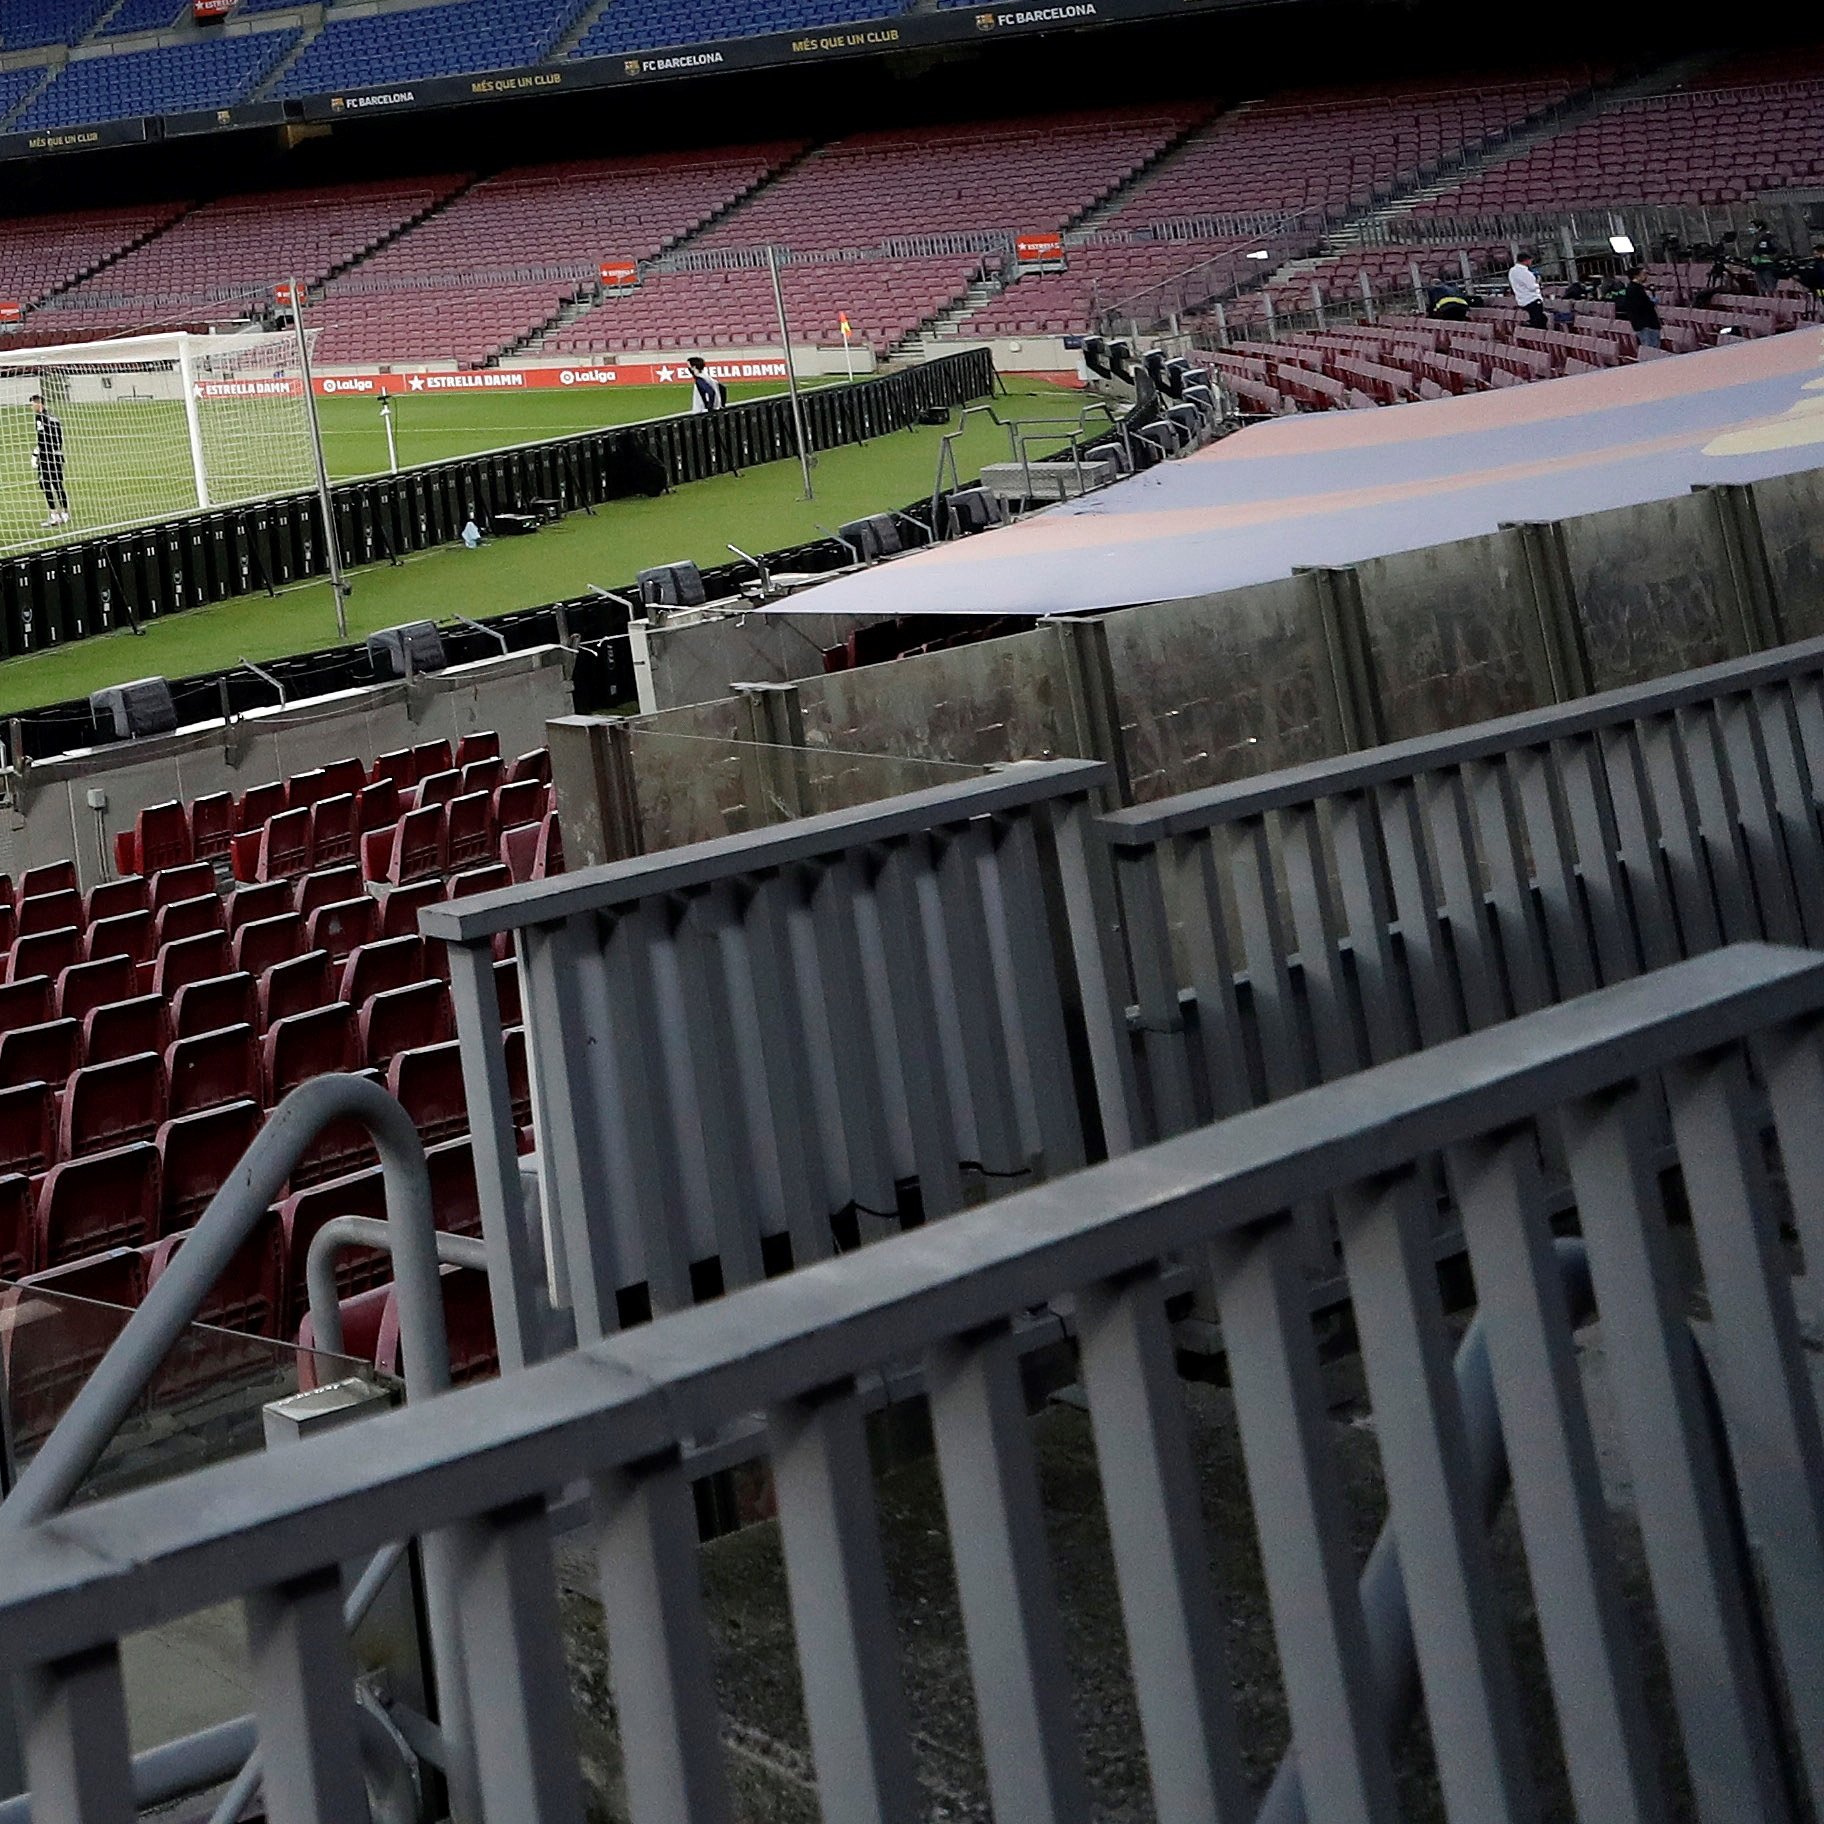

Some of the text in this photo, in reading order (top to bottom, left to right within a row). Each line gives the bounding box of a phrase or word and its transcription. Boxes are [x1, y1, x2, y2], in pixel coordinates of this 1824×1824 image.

[997, 2, 1097, 27] FC BARCELONA
[792, 29, 900, 53] MÉS QUE UN CLUB
[642, 51, 724, 72] FC BARCELONA
[471, 73, 562, 94] MÉS QUE UN CLUB
[346, 91, 415, 109] FC BARCELONA
[77, 132, 99, 144] CLUB
[575, 369, 616, 384] LaLiga
[742, 363, 787, 378] DAMM
[206, 382, 290, 395] ESTRELLA DAMM
[336, 377, 374, 391] LaLiga
[426, 373, 523, 389] ESTRELLA DAMM
